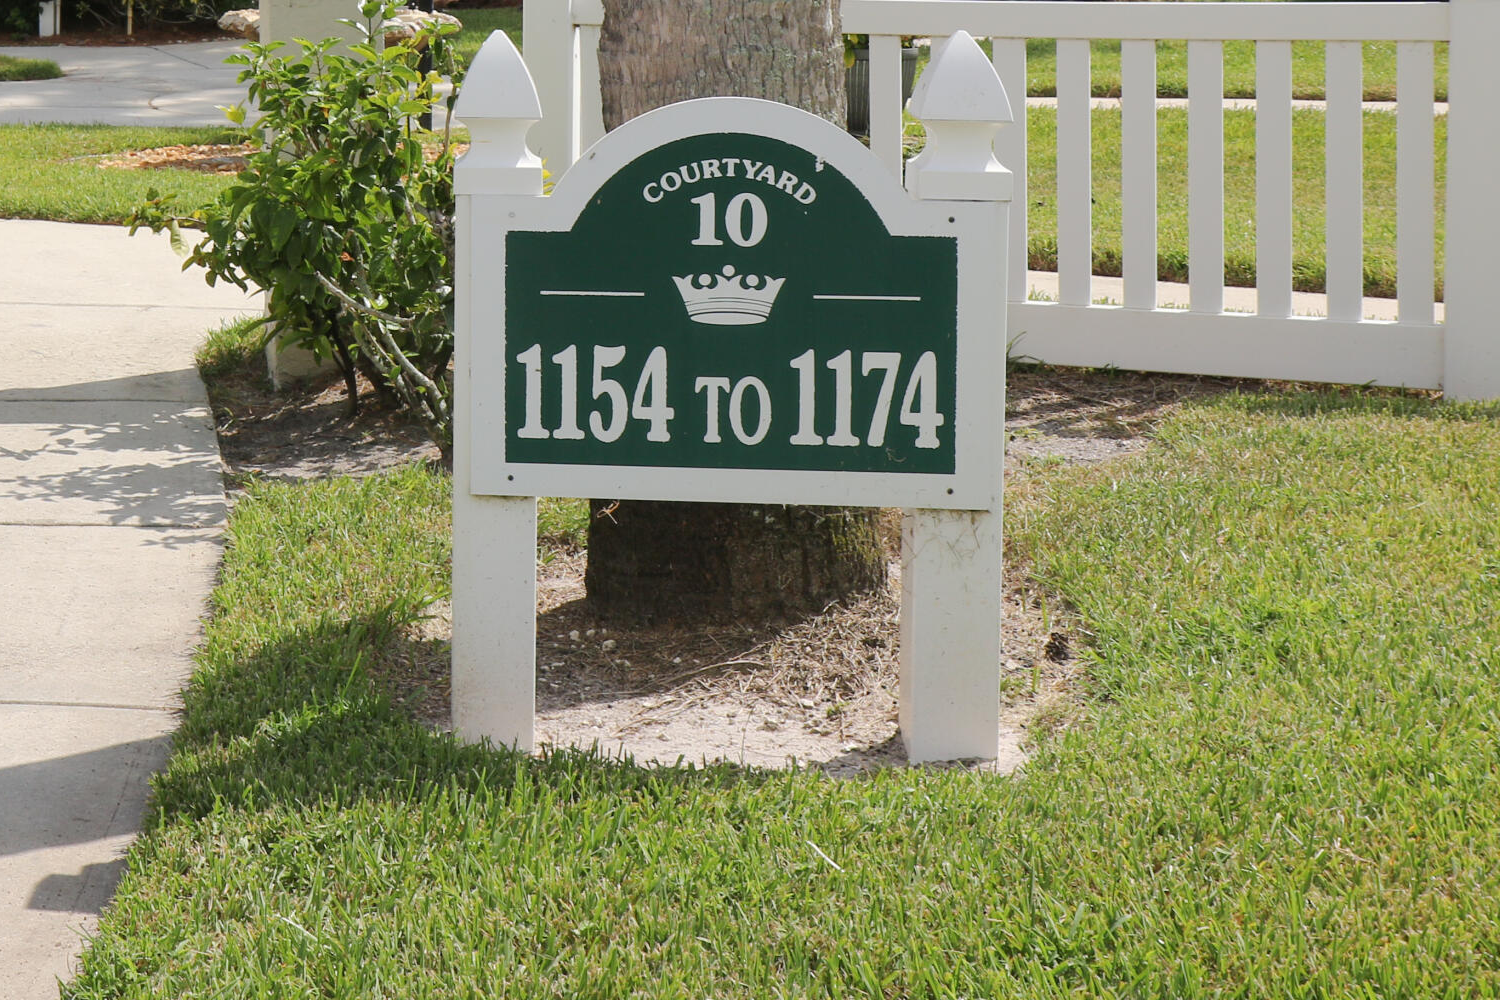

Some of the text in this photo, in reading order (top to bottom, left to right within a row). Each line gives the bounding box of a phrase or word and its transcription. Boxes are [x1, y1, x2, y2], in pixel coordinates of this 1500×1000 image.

[643, 158, 817, 205] COURTYARD
[690, 192, 768, 248] 10
[516, 343, 945, 450] 1154 TO 1174
